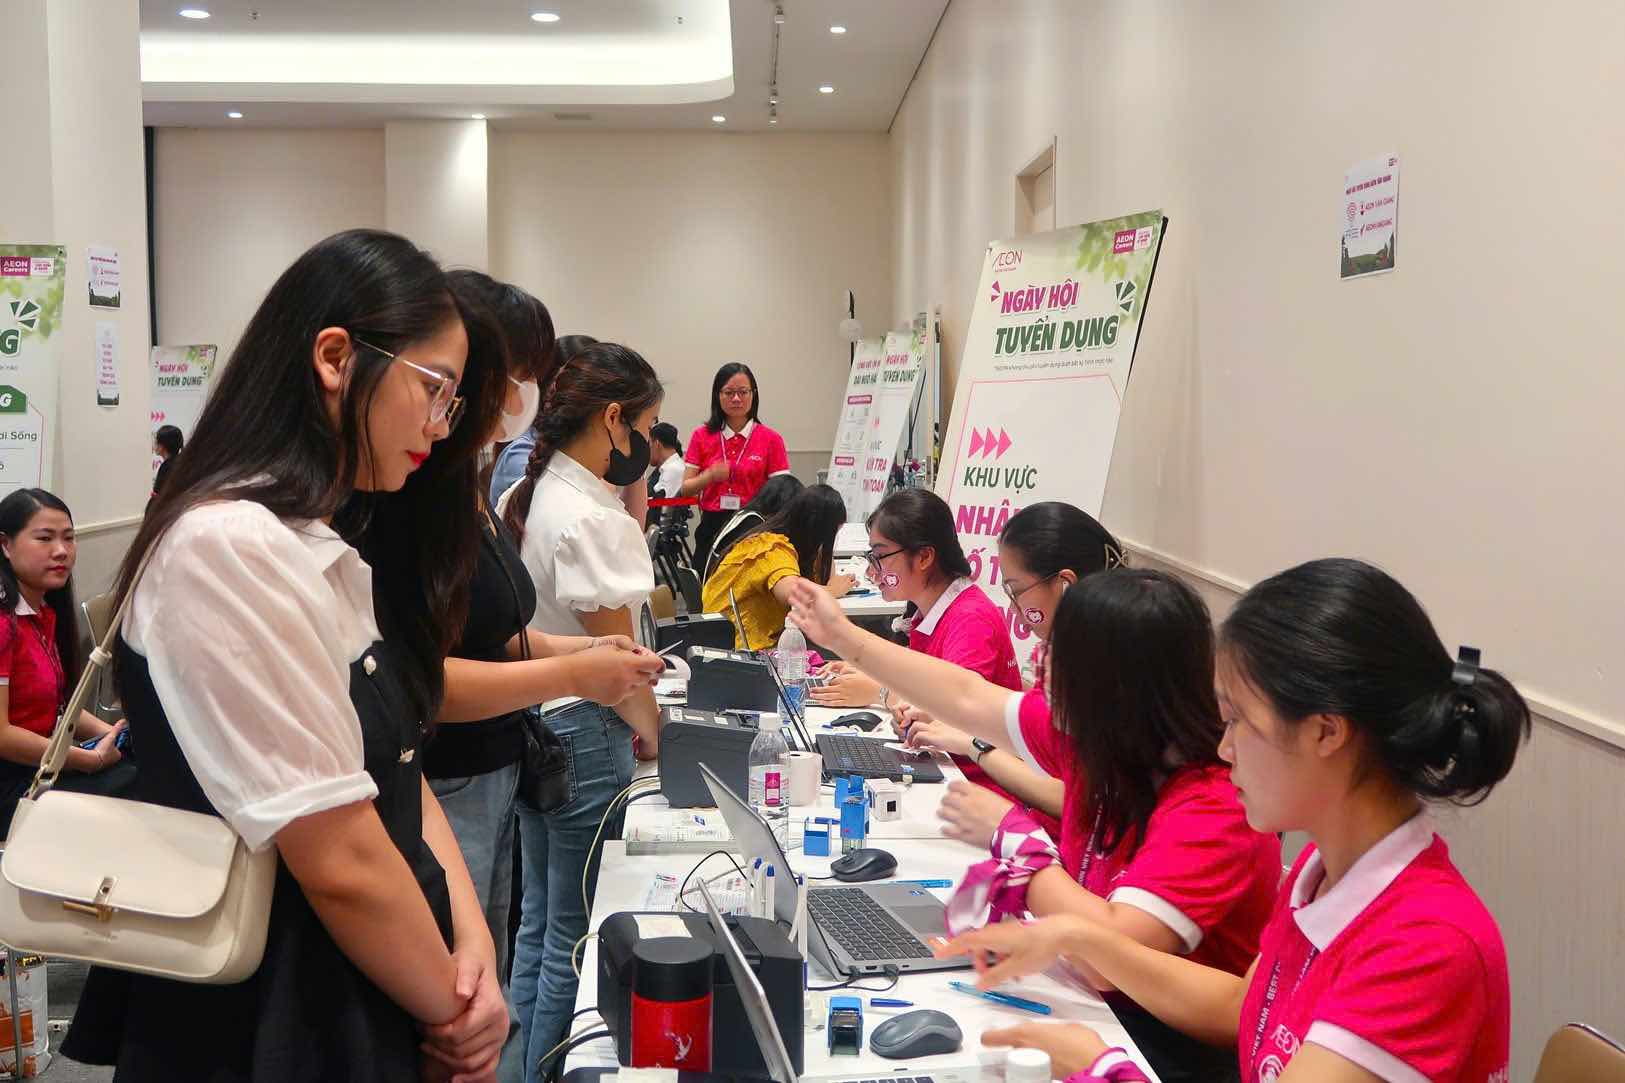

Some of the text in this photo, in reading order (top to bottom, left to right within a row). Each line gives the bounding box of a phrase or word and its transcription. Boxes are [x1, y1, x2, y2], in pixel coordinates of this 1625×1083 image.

[1001, 279, 1079, 314] NGÀY HỘI
[994, 316, 1119, 354] TUYỂN DỤNG
[963, 464, 1037, 494] KHU VỰC
[1257, 1008, 1270, 1032] NAM
